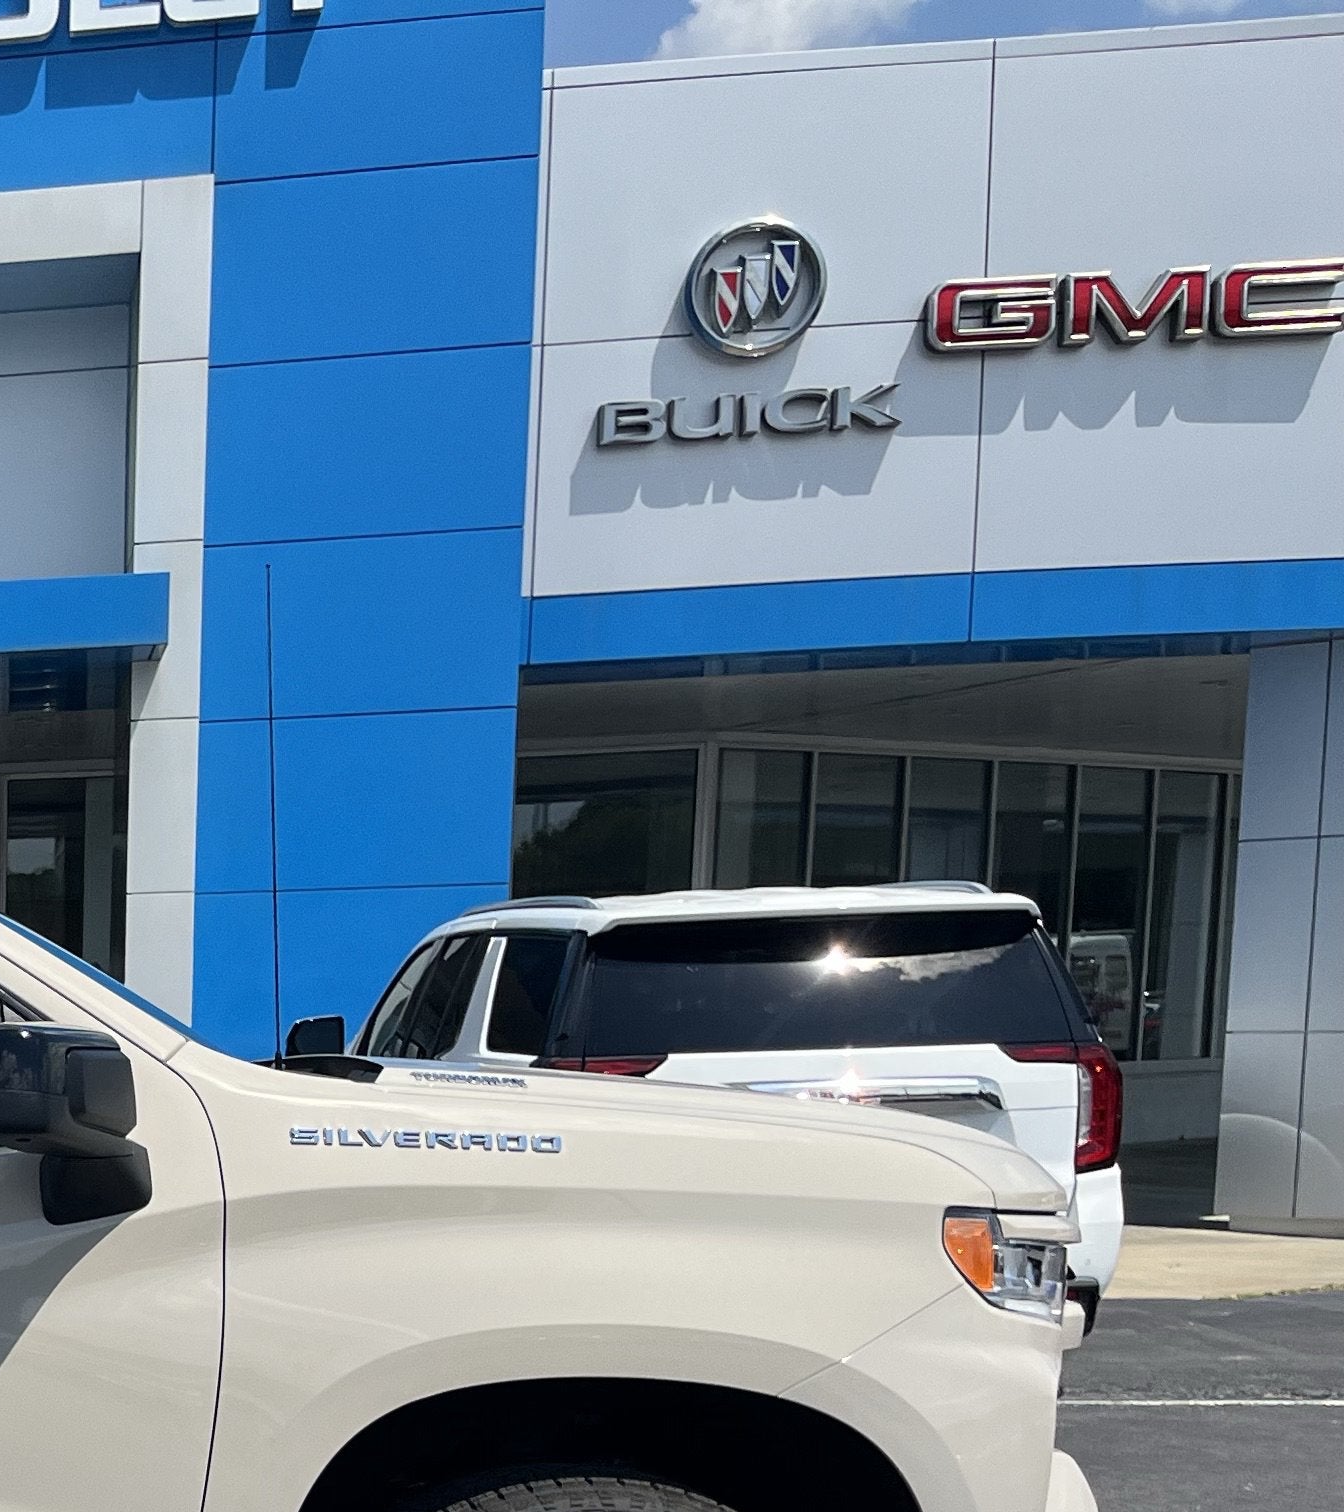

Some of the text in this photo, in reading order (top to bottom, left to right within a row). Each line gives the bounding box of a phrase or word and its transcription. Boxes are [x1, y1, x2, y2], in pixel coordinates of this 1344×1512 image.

[926, 257, 1344, 353] GMC
[596, 381, 902, 448] BUICK
[289, 1126, 563, 1153] SILVERADO
